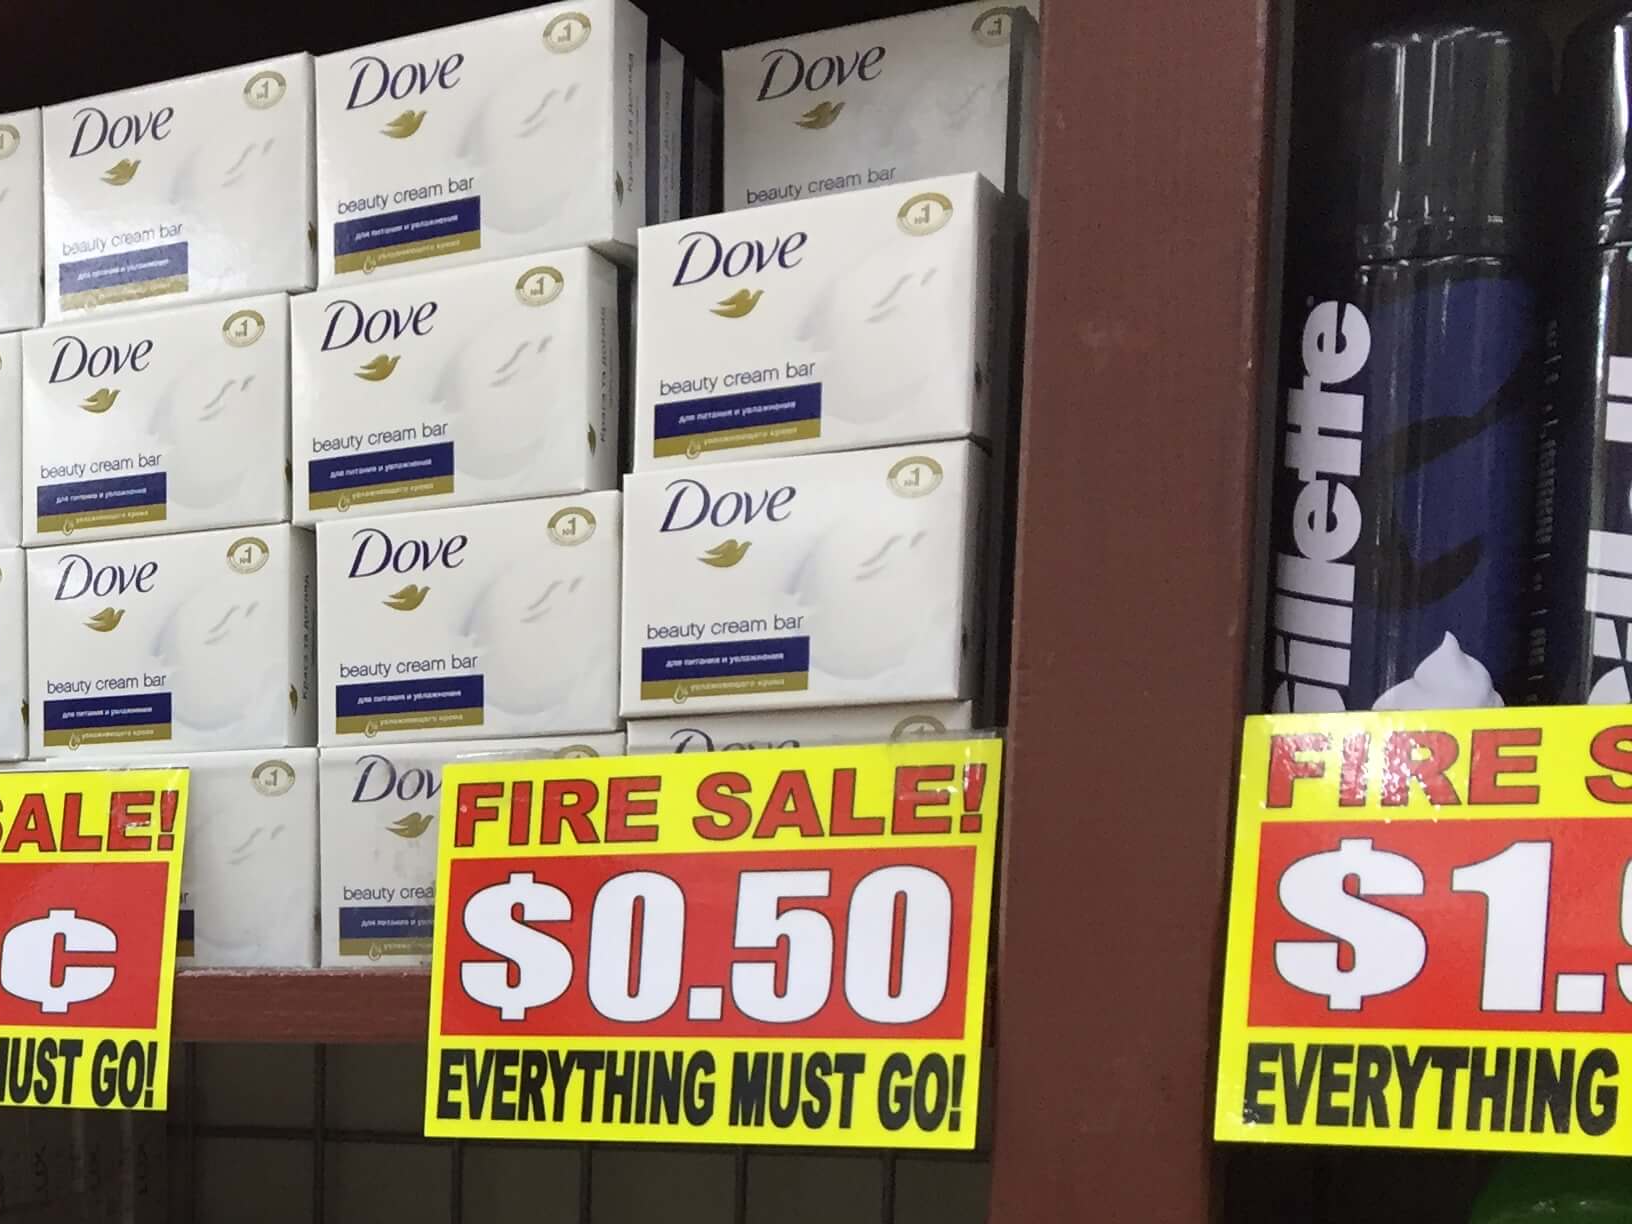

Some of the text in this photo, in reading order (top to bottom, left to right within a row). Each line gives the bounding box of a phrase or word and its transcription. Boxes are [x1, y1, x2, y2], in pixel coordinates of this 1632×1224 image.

[345, 51, 465, 110] Dove
[756, 46, 886, 102] Dove
[68, 105, 175, 158] Dove
[746, 166, 897, 205] beauty cream bar
[671, 230, 808, 288] Dove
[48, 336, 154, 385] Dove
[660, 361, 817, 396] beauty cream bar
[659, 479, 797, 534] Dove
[647, 613, 804, 641] beauty cream bar
[1266, 727, 1543, 809] FIRE
[453, 763, 988, 848] FIRE SALE!
[459, 864, 953, 1025] $0.50
[1273, 837, 1632, 1014] $1.
[91, 1038, 158, 1108] GO!
[436, 1048, 966, 1132] EVERYTHING MUST GO!
[1242, 1041, 1620, 1137] EVERYTHING
